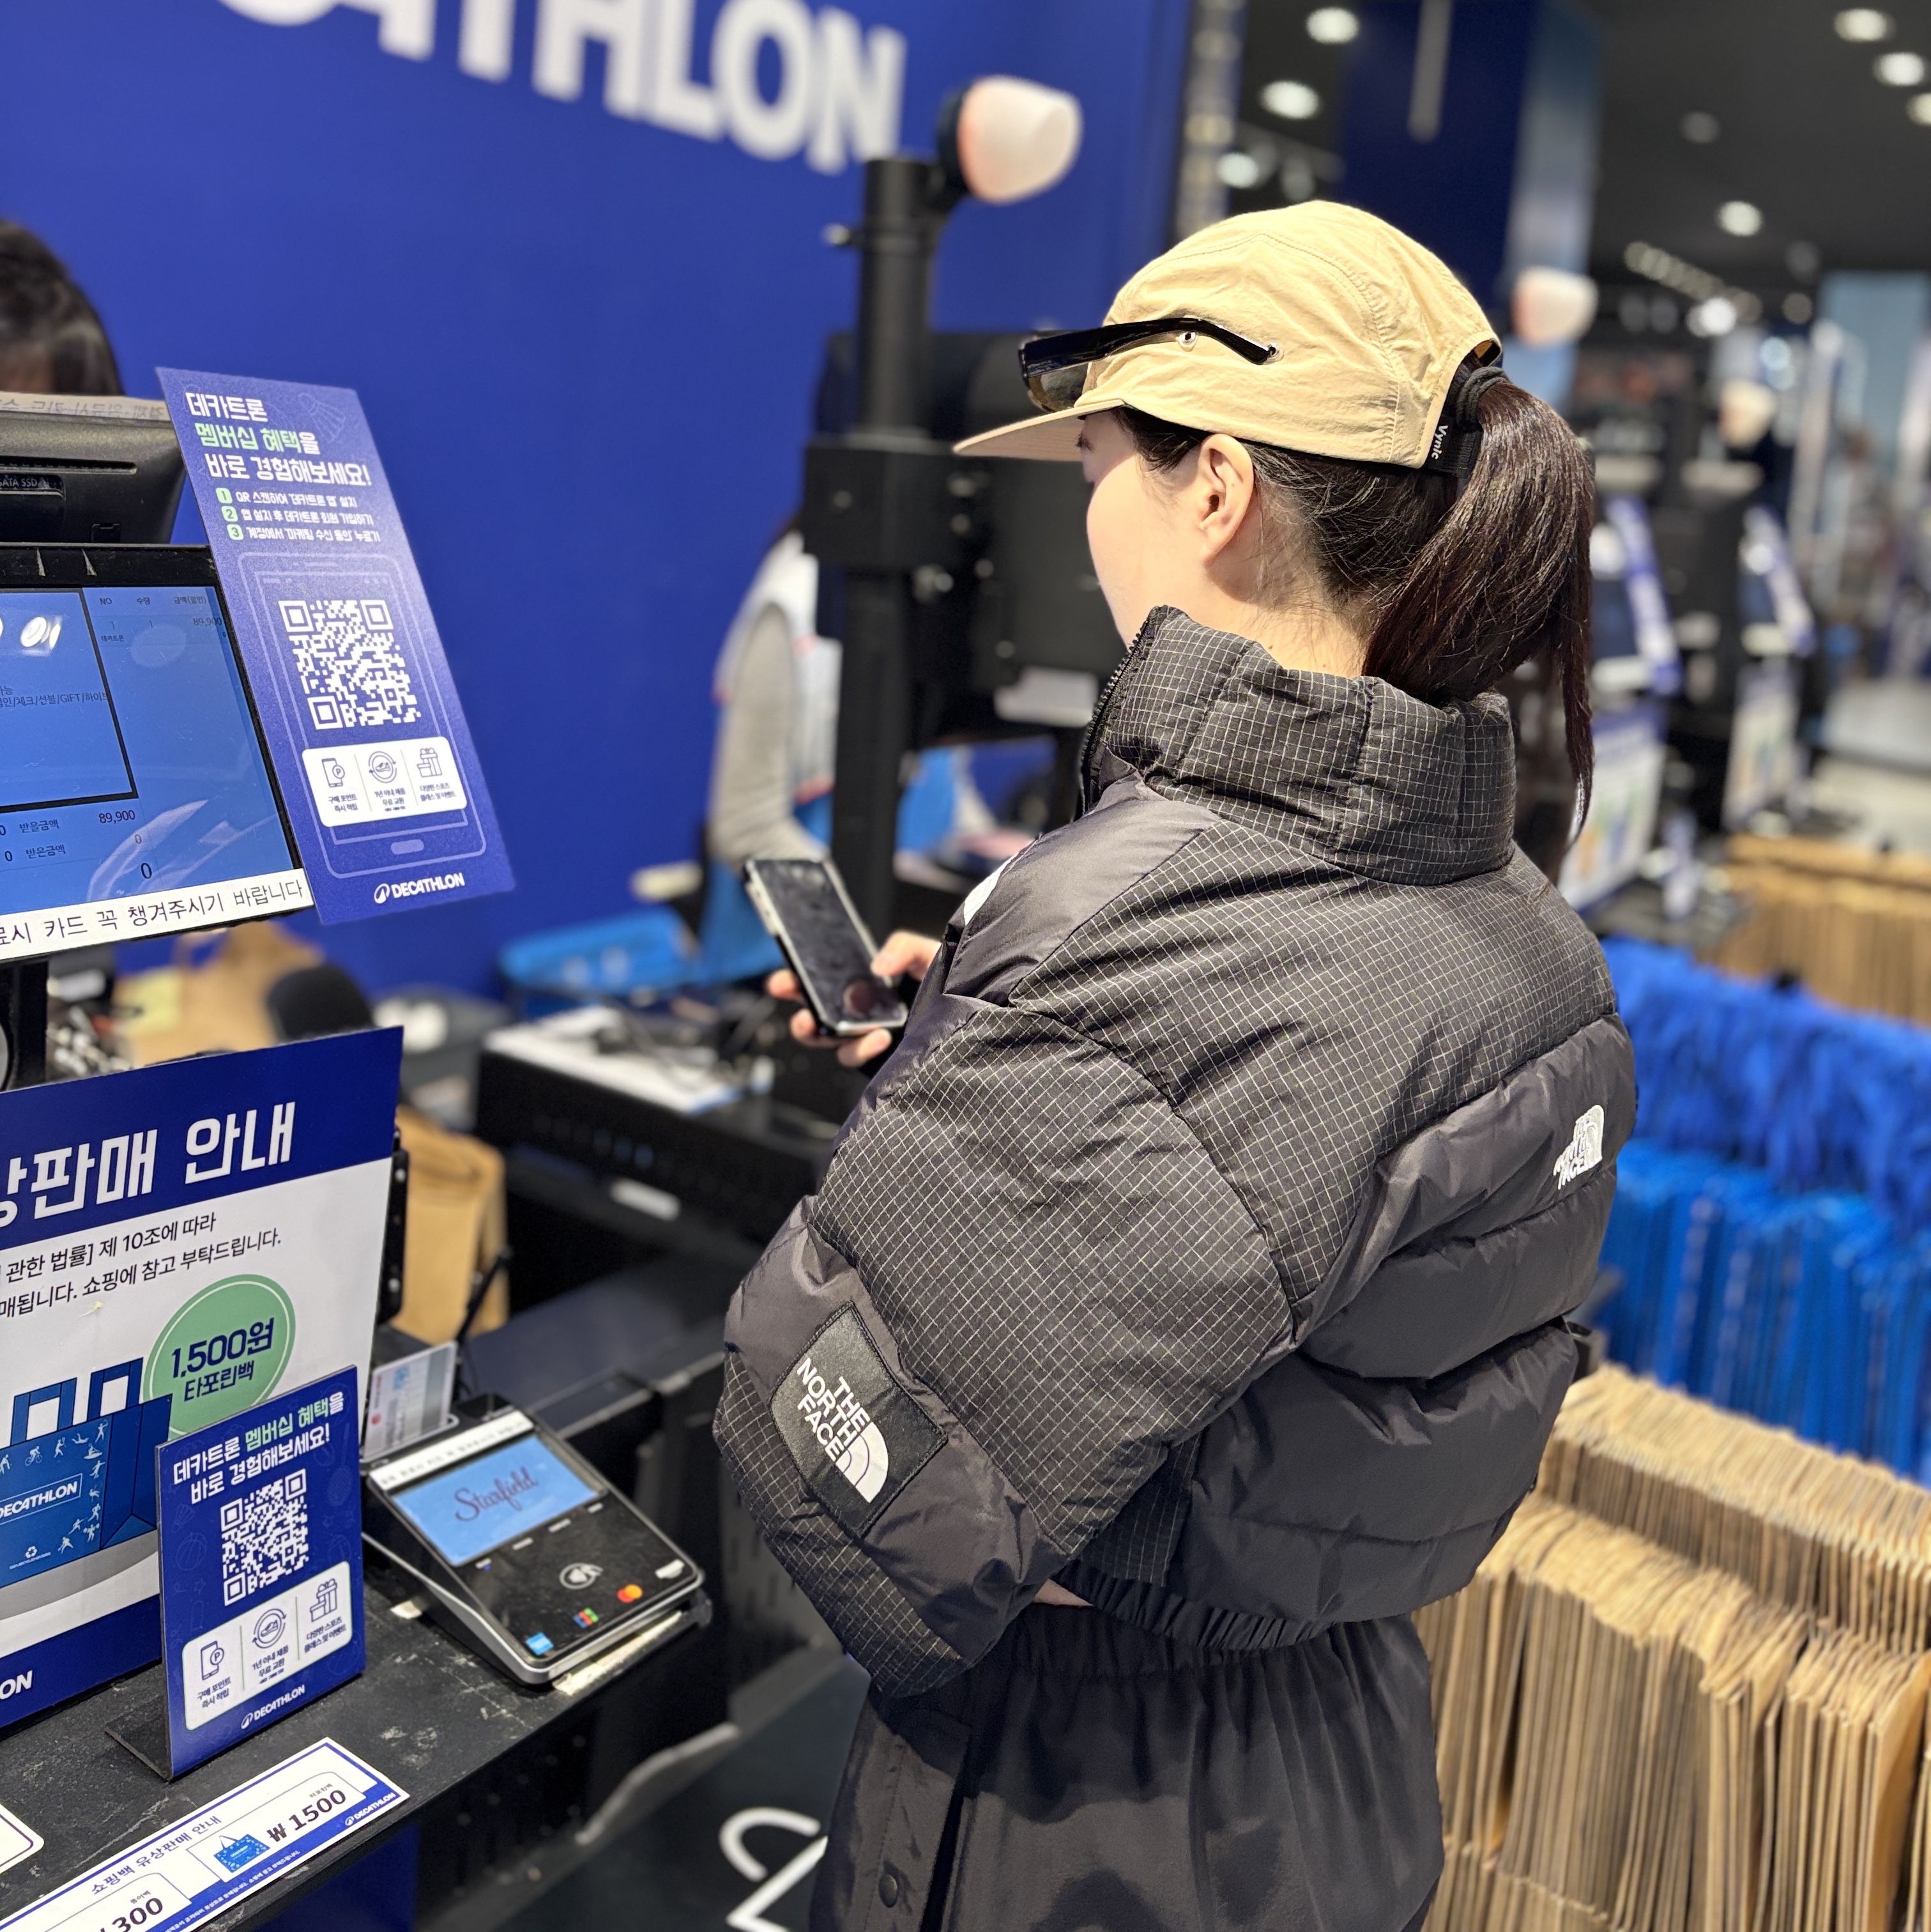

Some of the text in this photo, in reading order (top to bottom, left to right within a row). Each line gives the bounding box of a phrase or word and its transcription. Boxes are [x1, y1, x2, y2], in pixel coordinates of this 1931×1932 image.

[185, 392, 268, 422] 데카트론
[195, 423, 320, 455] 멤버십 혜택을
[1431, 425, 1449, 460] Vynic
[21, 478, 38, 487] SSD
[204, 453, 372, 486] 바로 경험해보세요!
[220, 490, 227, 501] 1
[236, 491, 250, 502] QR
[253, 493, 288, 505] 스캔하여
[339, 496, 358, 508] 설치
[225, 509, 374, 526] 2 앱 설치 후 데카트론 회원 가입하기
[231, 527, 240, 537] 3
[246, 526, 285, 540] 계정에서
[316, 529, 333, 541] 수신
[353, 530, 381, 542] 누르기
[19, 818, 59, 833] 받을금액
[98, 809, 135, 824] 89,900
[4, 833, 142, 862] 0 받은금액 0
[140, 862, 152, 879] 0
[391, 872, 466, 898] DECATHLON
[44, 916, 88, 939] 카드
[97, 910, 118, 930] 꼭
[128, 893, 224, 926] 챙겨주시기
[233, 879, 303, 907] 바랍니다
[185, 1101, 296, 1184] 안내
[6, 1211, 217, 1284] 관한 법률] 제 10조에 따라
[82, 1264, 137, 1296] 쇼핑에
[141, 1256, 176, 1281] 참고
[180, 1227, 282, 1271] 부탁드립니다.
[184, 1360, 255, 1402] 타포린백
[797, 1357, 858, 1447] NORTH
[833, 1376, 871, 1432] THE
[173, 1436, 241, 1485] 데카트론
[245, 1413, 293, 1452] 멤버십
[298, 1391, 344, 1428] 혜택을
[797, 1393, 845, 1462] FACE
[191, 1470, 225, 1505] 바로
[229, 1422, 330, 1485] 경험해보세요!
[454, 1466, 540, 1521] Starfield
[252, 1659, 262, 1670] 1년
[258, 1665, 271, 1678] 무료
[272, 1657, 285, 1671] 교환
[197, 1676, 231, 1700] 구매 포인트
[202, 1688, 229, 1708] 즉시 적립
[254, 1684, 306, 1721] DECATHLON
[266, 1790, 346, 1843] ₩ 1500
[353, 1792, 397, 1820] DECATHLON
[91, 1816, 222, 1895] 쇼핑백 유상판매 안내
